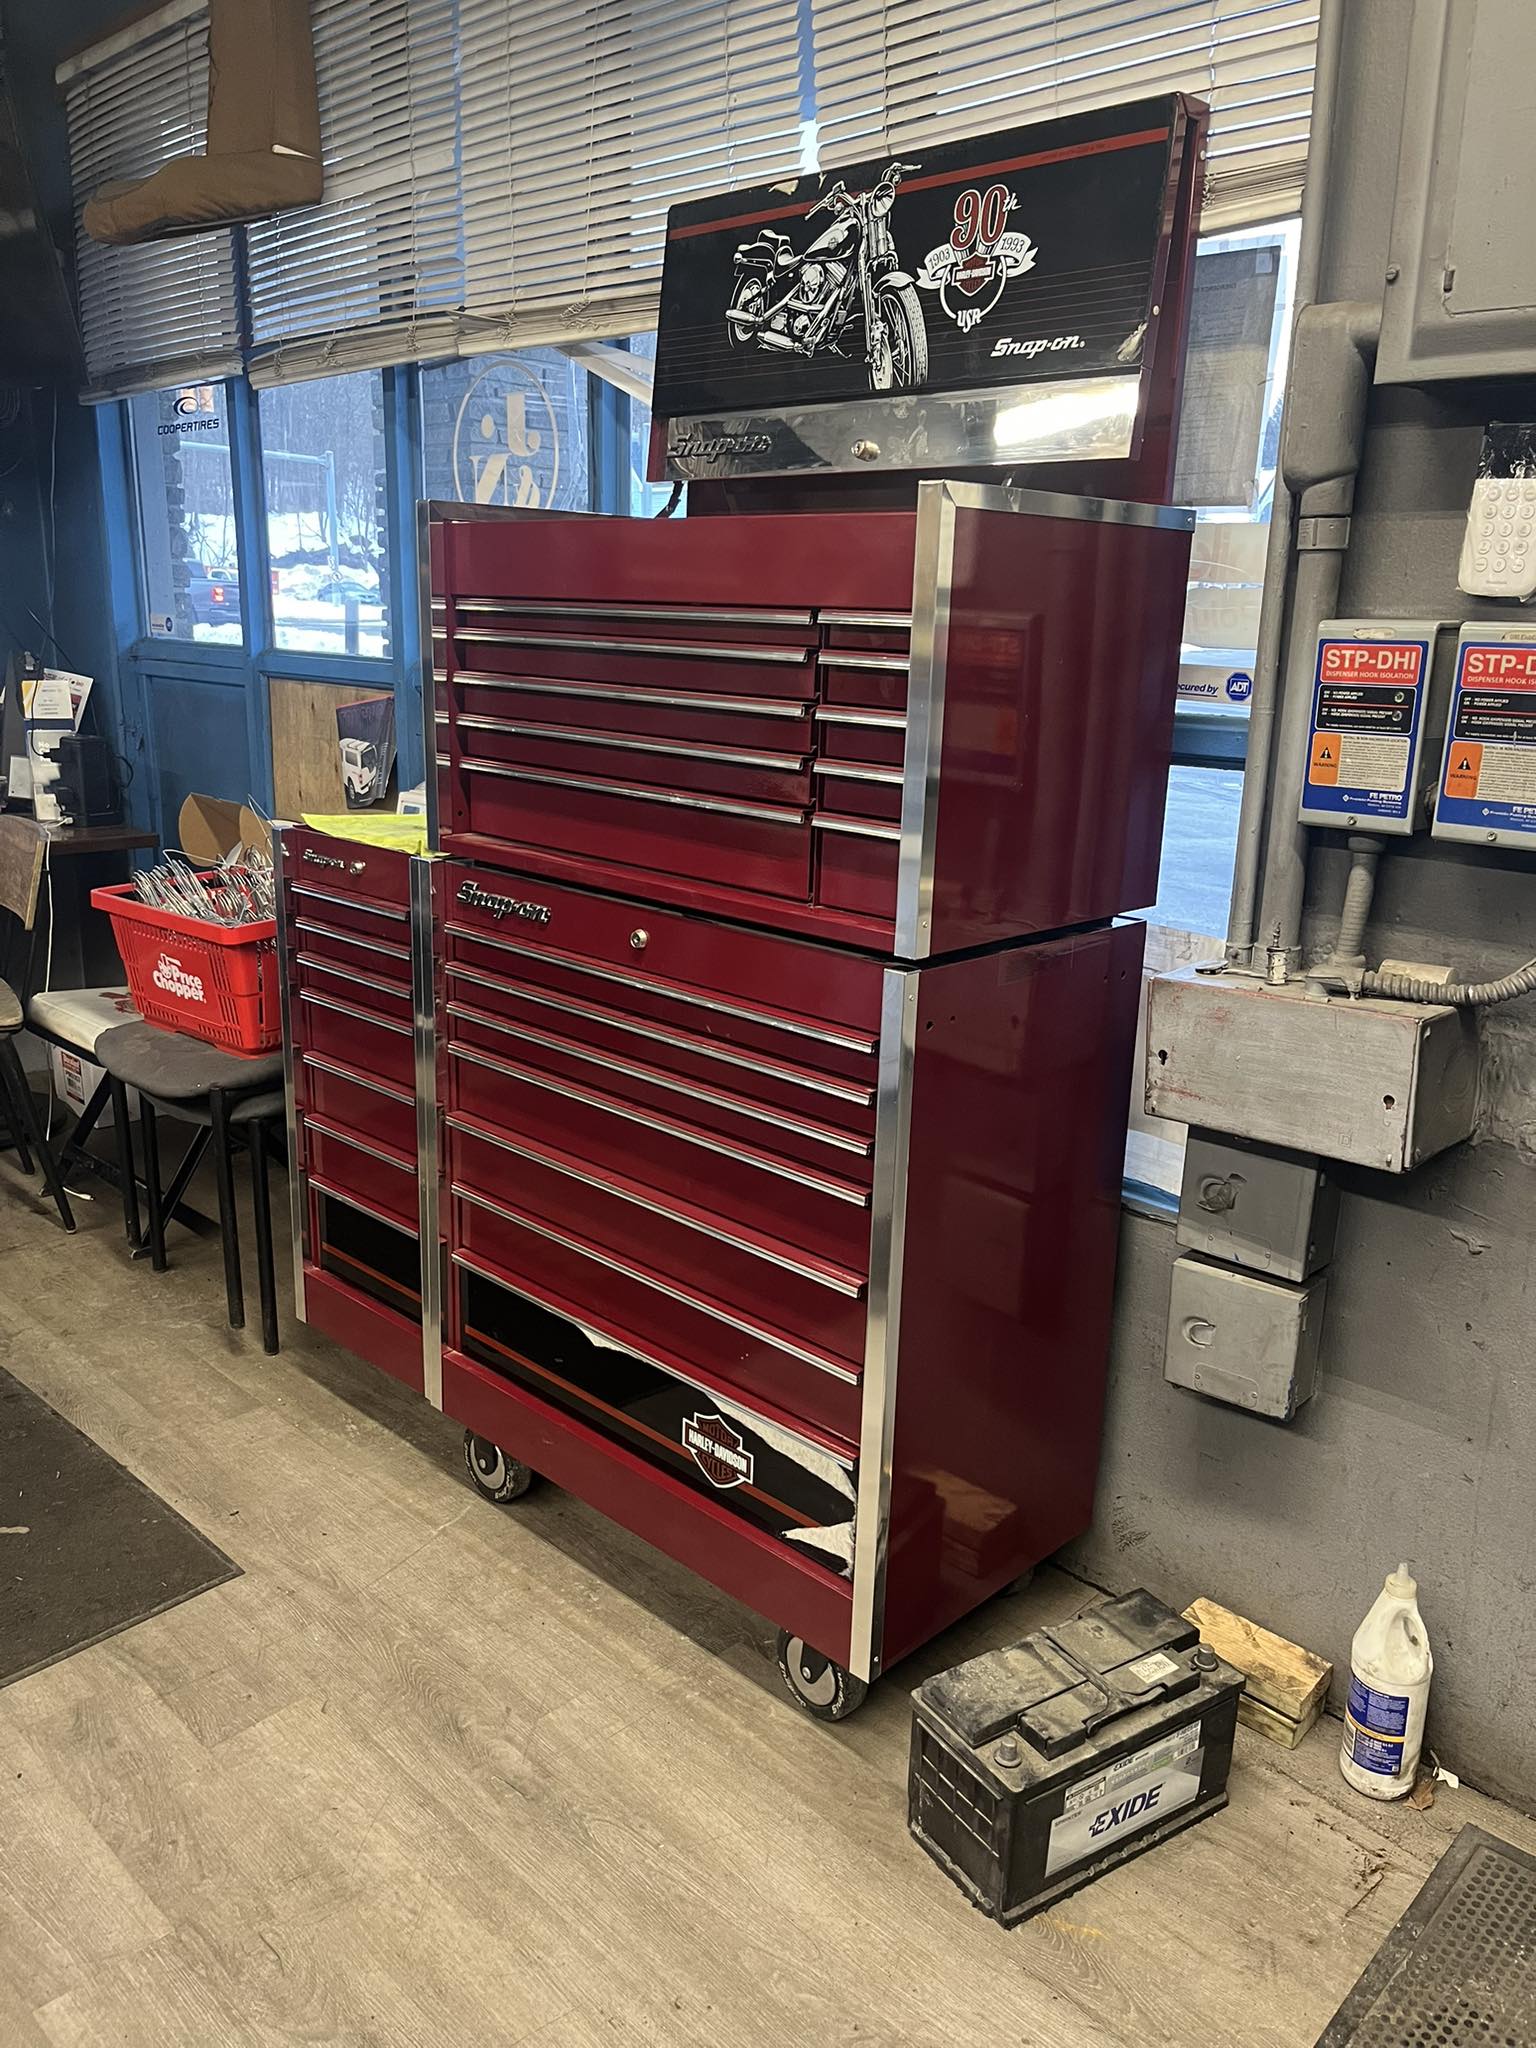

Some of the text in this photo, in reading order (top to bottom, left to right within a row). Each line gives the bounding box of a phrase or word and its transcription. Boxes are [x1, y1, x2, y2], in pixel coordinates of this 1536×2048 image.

[1001, 237, 1025, 253] 1993
[929, 250, 950, 269] 1903
[956, 308, 982, 333] USA
[1326, 649, 1417, 670] STP-DHI
[1178, 684, 1218, 694] cured by
[1230, 681, 1249, 693] ADT
[1467, 676, 1504, 684] DISPENSER
[1505, 677, 1527, 685] HOOK
[456, 880, 551, 923] Snap-on
[1088, 1782, 1166, 1838] EXIDE
